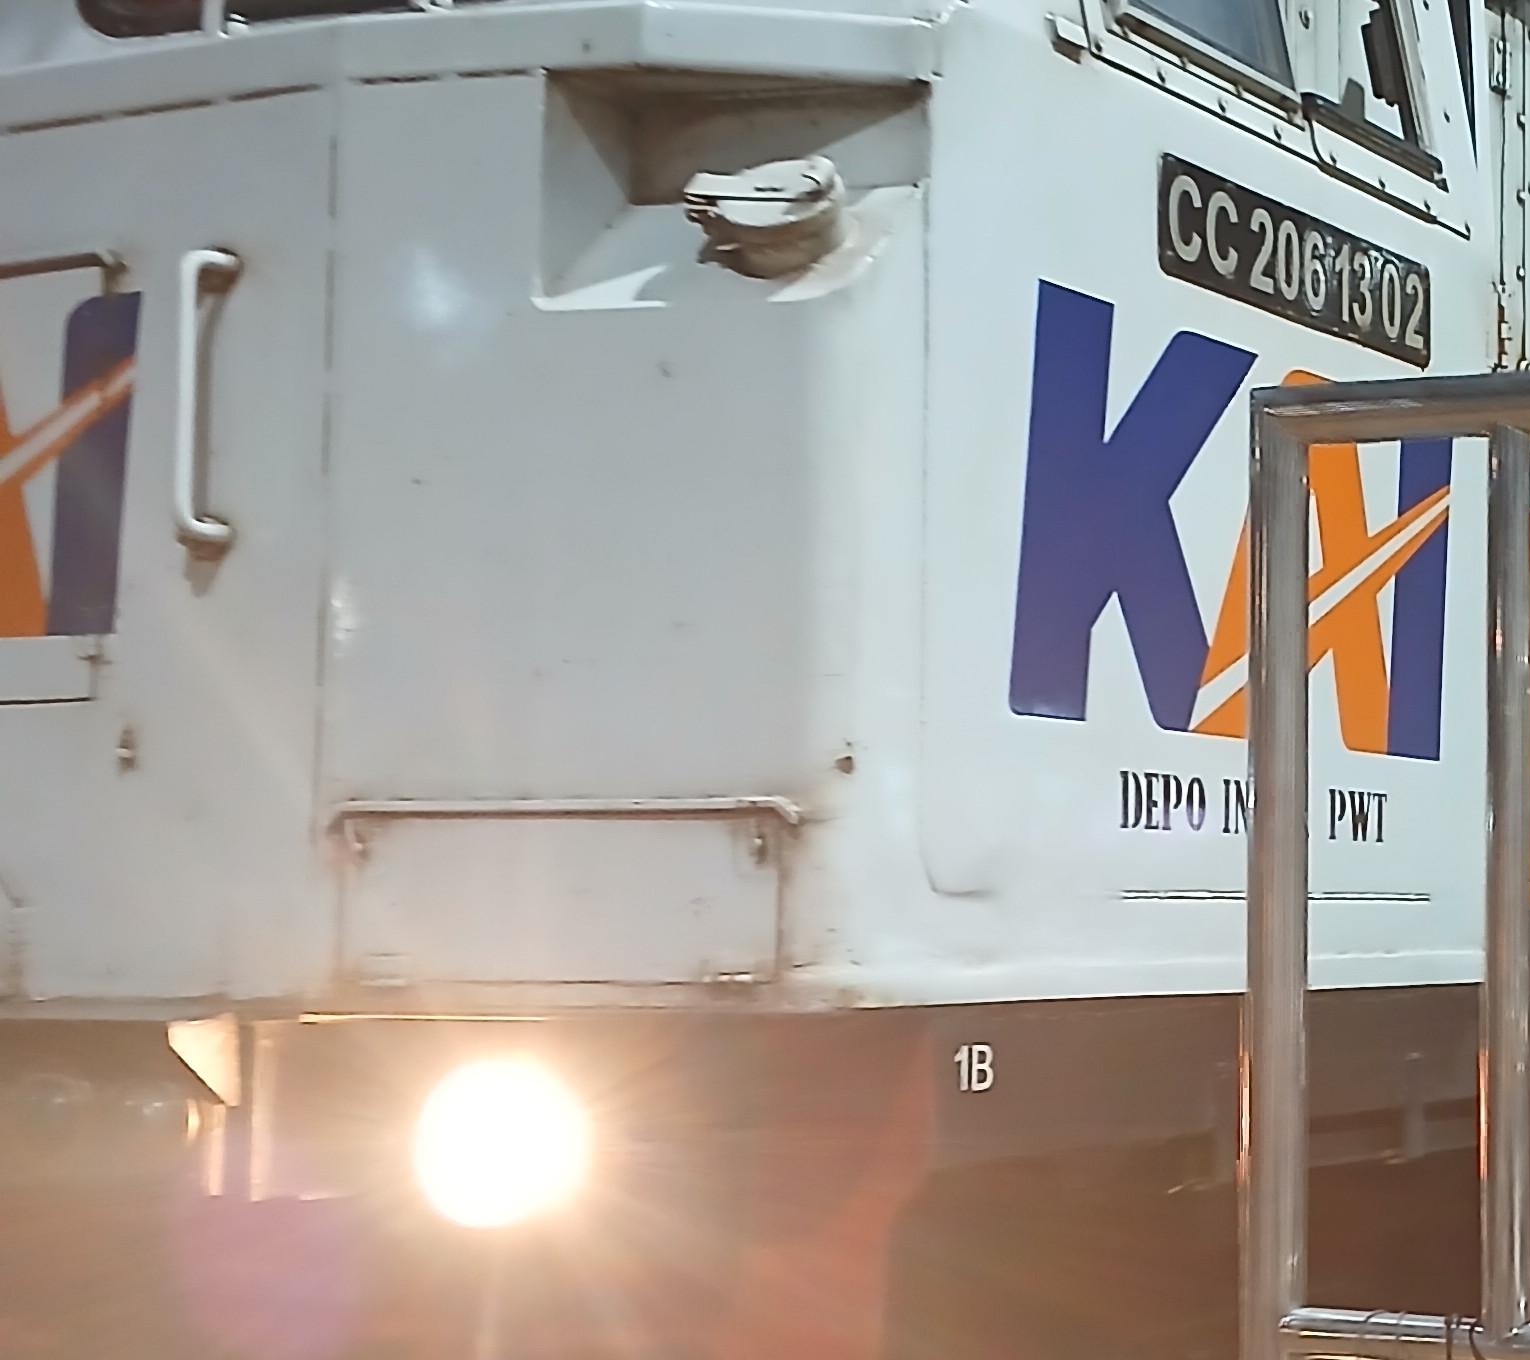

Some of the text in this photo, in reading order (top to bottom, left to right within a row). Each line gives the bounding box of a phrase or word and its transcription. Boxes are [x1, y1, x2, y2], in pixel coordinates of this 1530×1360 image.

[1168, 174, 1239, 276] CC
[1009, 278, 1453, 762] KAI
[1119, 770, 1206, 831] DEPO
[1328, 788, 1387, 843] PWT
[953, 1044, 994, 1091] 1B
